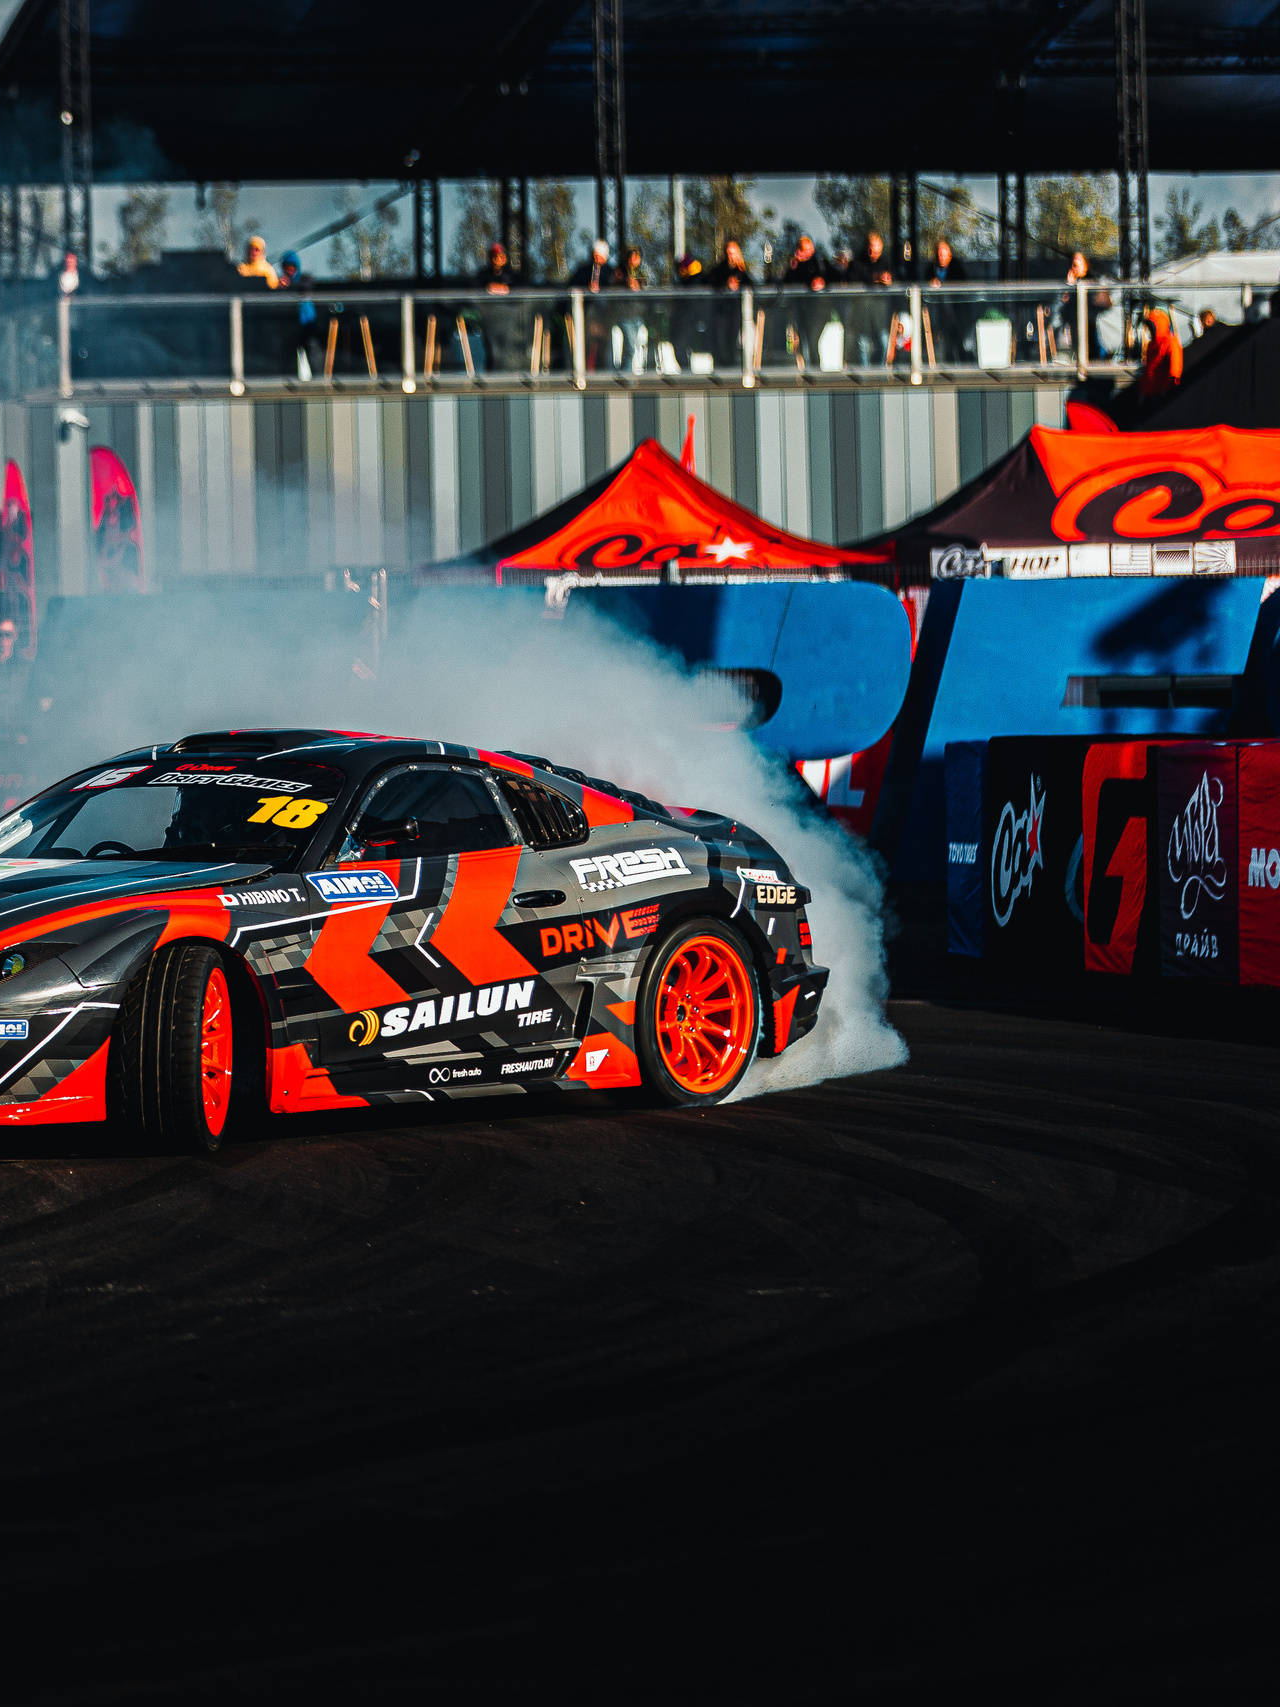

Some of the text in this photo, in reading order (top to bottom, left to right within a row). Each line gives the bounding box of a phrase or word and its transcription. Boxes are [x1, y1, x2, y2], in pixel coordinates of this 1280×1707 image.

[247, 795, 329, 829] 18
[569, 847, 694, 893] FRESH
[317, 875, 394, 895] AIMOL
[756, 885, 797, 905] EDGE
[236, 887, 306, 906] HIBINO T.
[380, 980, 535, 1037] SAILUN
[517, 1008, 553, 1028] TIRE
[501, 1057, 554, 1075] FRESHAUTO.RU
